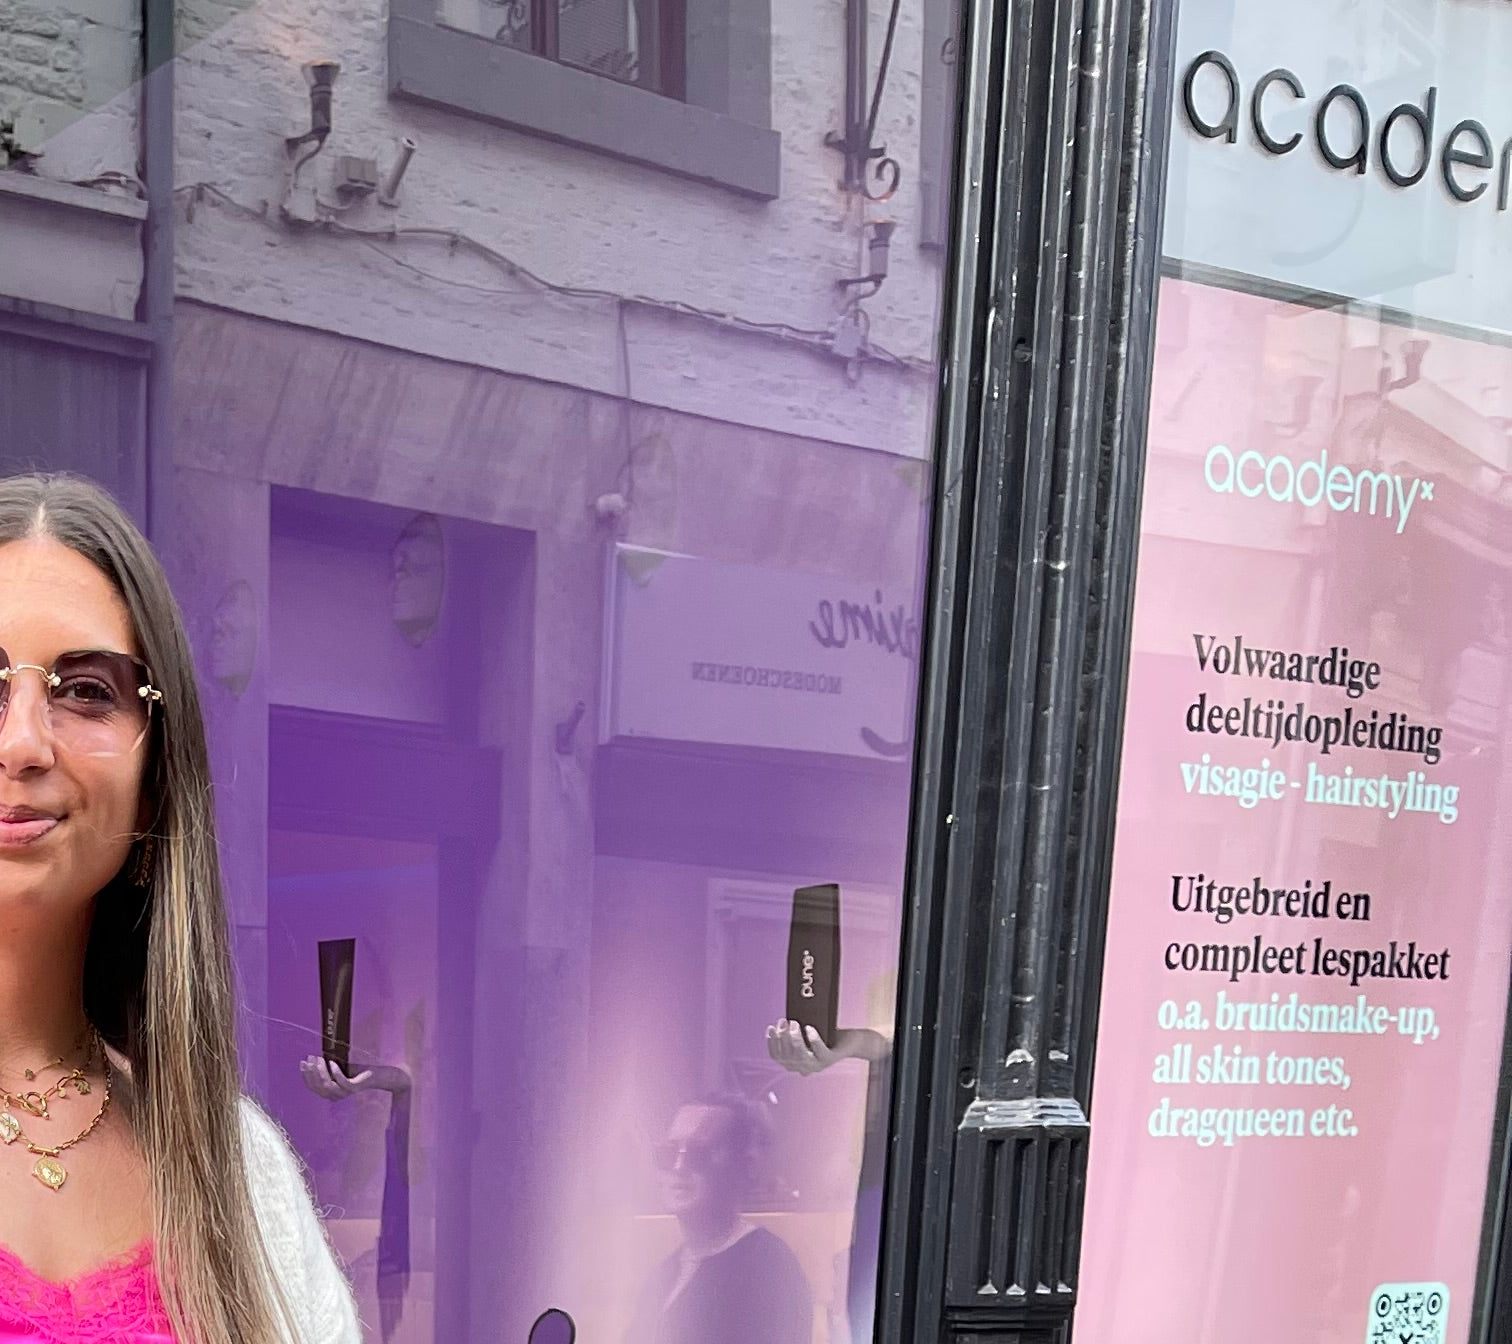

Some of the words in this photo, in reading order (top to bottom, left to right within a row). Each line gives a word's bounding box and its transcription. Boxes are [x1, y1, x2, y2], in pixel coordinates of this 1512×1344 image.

[1193, 633, 1381, 699] Volwaardige
[1186, 693, 1443, 765] deeltijdopleiding
[1180, 753, 1286, 808] visagie
[1304, 762, 1460, 824] hairstyling
[1171, 873, 1331, 924] Uitgebreid
[1336, 890, 1371, 921] en
[1165, 935, 1307, 982] compleet
[1311, 937, 1451, 986] lespakket
[1157, 999, 1210, 1031] o.a.
[1215, 990, 1440, 1045] bruidsmake-up,
[1152, 1044, 1192, 1084] all
[1196, 1044, 1260, 1085] skin
[1266, 1051, 1351, 1090] tones,
[1148, 1098, 1305, 1147] dragqueen
[1310, 1104, 1359, 1137] etc.
